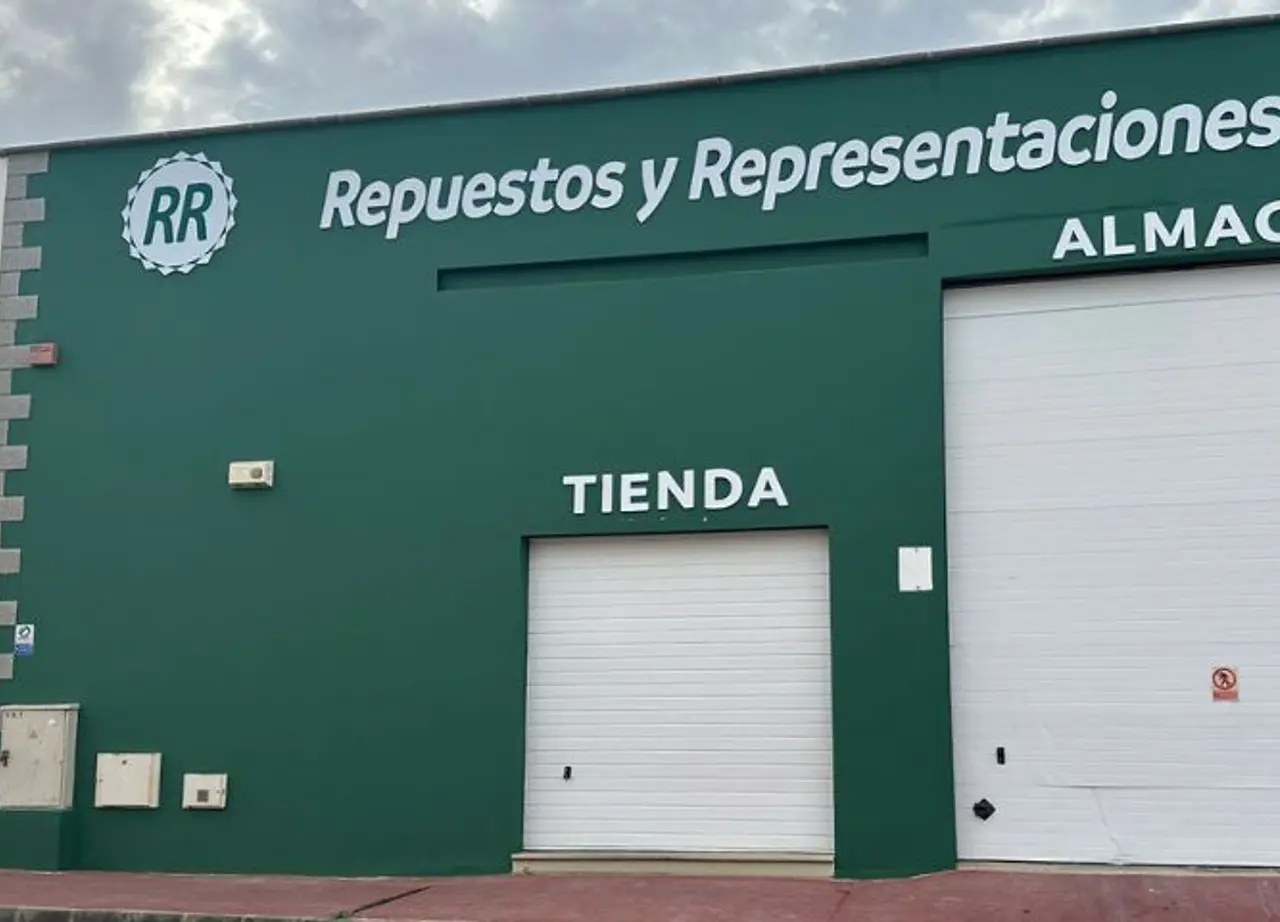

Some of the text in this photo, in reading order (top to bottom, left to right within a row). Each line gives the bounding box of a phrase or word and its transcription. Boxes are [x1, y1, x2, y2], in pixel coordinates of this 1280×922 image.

[142, 183, 214, 246] RR
[319, 157, 626, 241] Repuestos
[636, 157, 679, 224] y
[562, 466, 790, 515] TIENDA
